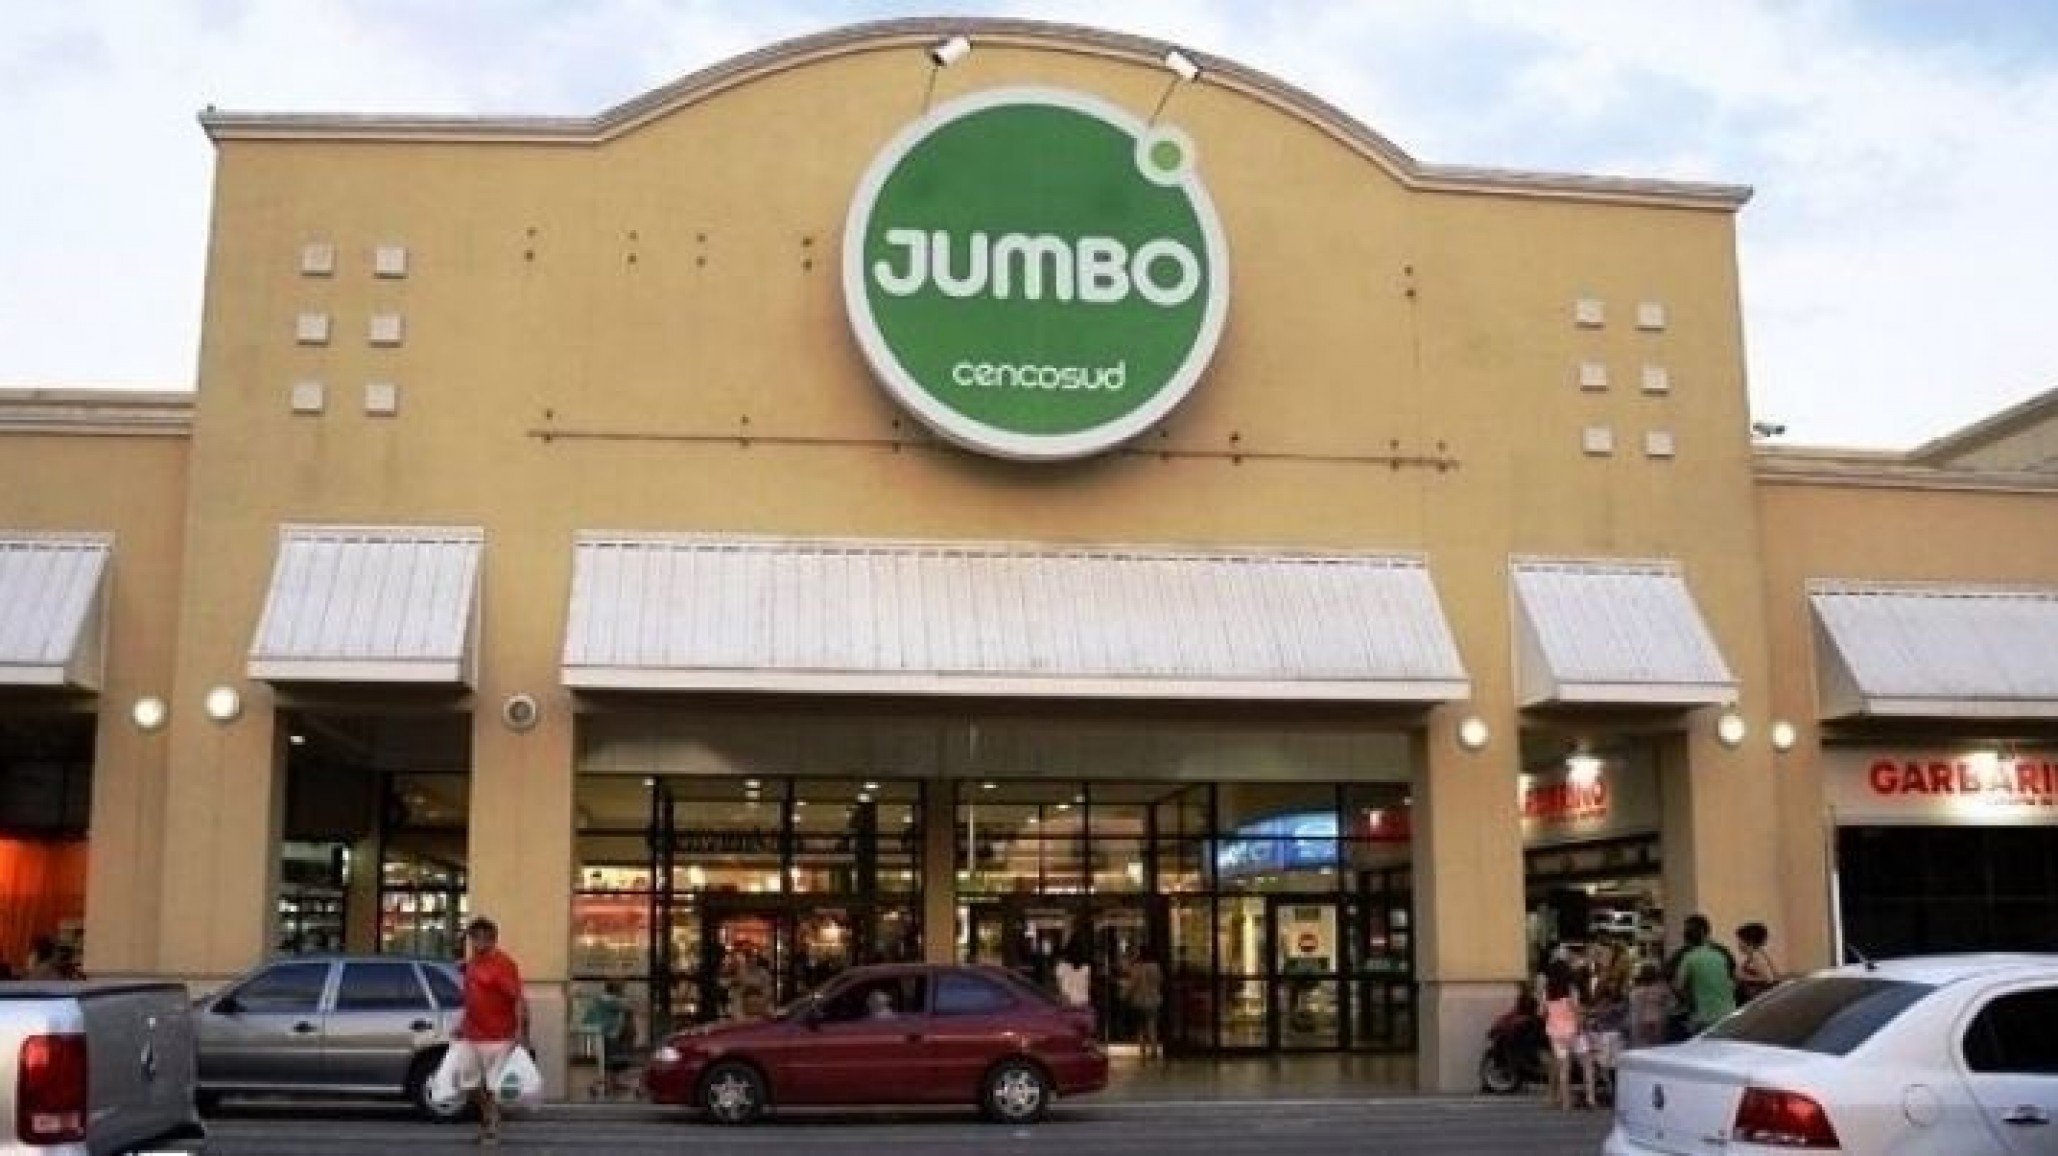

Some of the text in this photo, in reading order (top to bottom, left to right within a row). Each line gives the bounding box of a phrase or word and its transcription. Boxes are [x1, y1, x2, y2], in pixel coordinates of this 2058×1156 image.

[873, 228, 1201, 307] JUMBO
[952, 360, 1126, 390] cencosud
[1869, 759, 2058, 796] GARBARI
